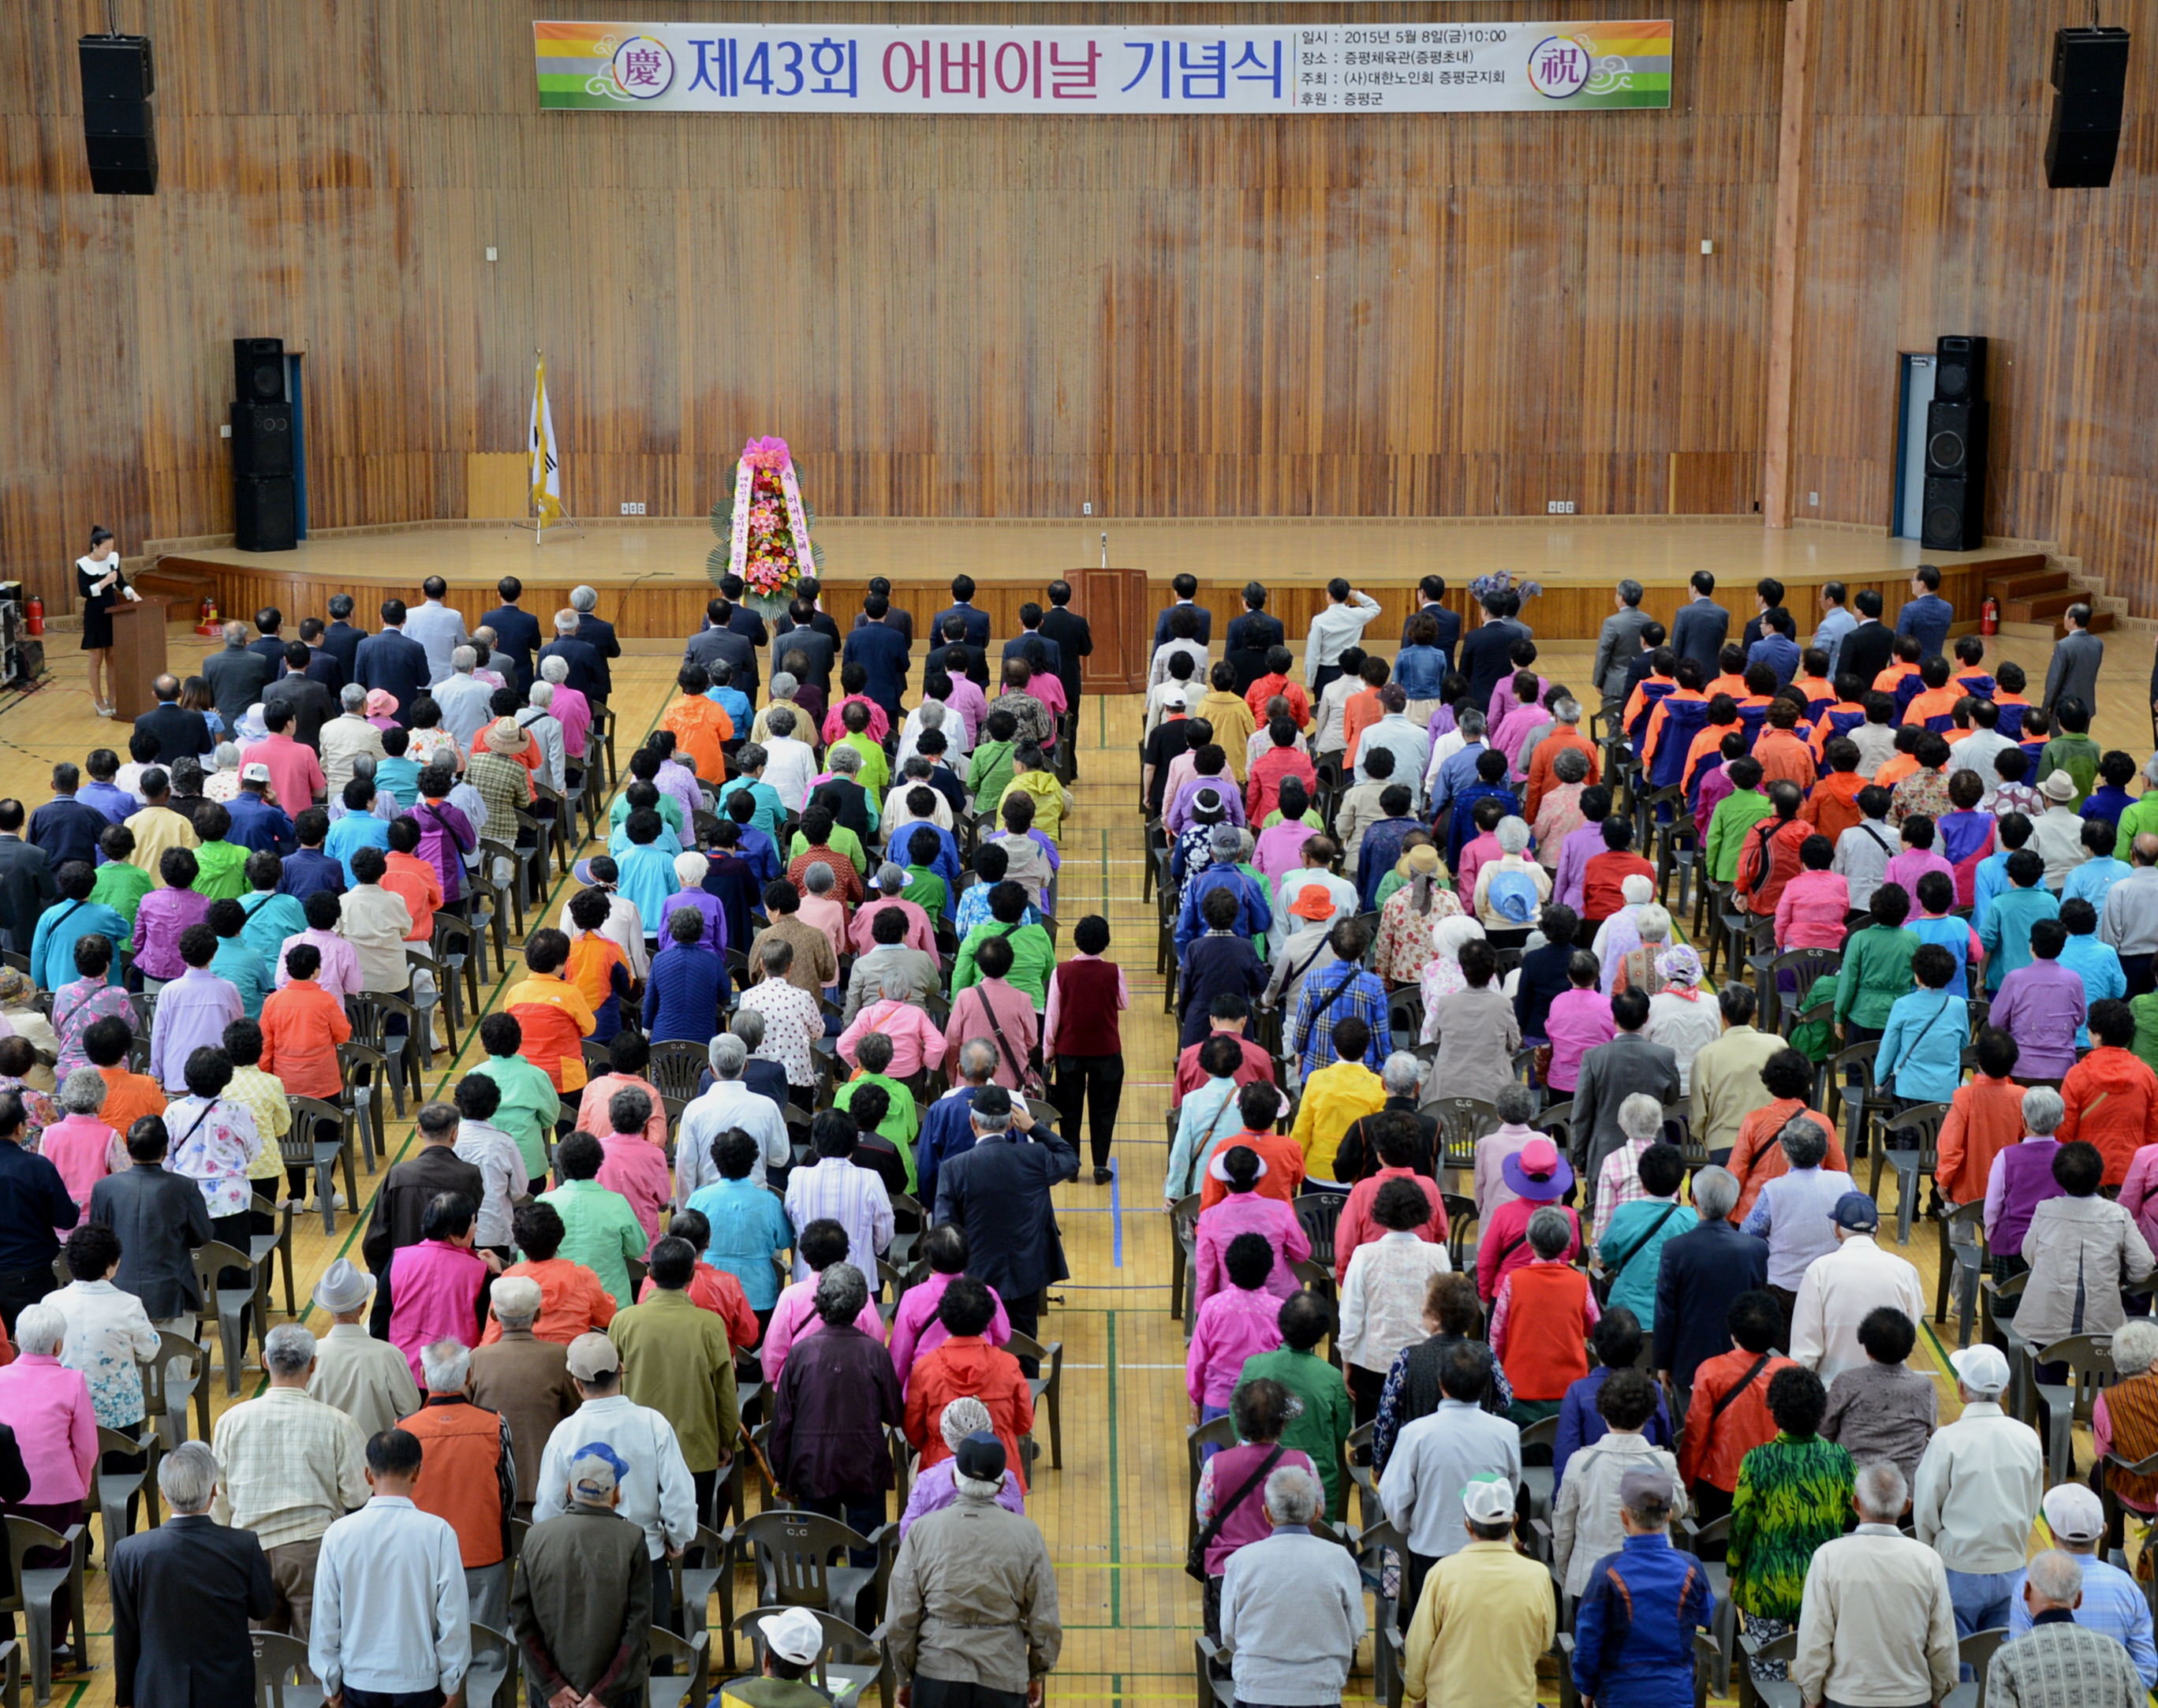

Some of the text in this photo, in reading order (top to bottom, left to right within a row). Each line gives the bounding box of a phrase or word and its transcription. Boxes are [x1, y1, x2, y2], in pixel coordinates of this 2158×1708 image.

[1301, 32, 1327, 45] 일시
[1345, 31, 1390, 44] 2015년
[1395, 30, 1417, 44] 5월
[1301, 52, 1327, 65] 장소
[1344, 50, 1473, 65] 증평체육관(증평초내)
[623, 48, 662, 86] 慶
[687, 37, 1282, 99] 제43회 어버이날 기념식
[1540, 47, 1580, 84] 祝
[1301, 72, 1327, 86] 주최
[1344, 72, 1433, 86] (사)대한노인회
[1439, 70, 1505, 85] 증평군지회
[1301, 92, 1327, 106] 후원
[1344, 92, 1383, 106] 증평군
[786, 1527, 808, 1537] C.C
